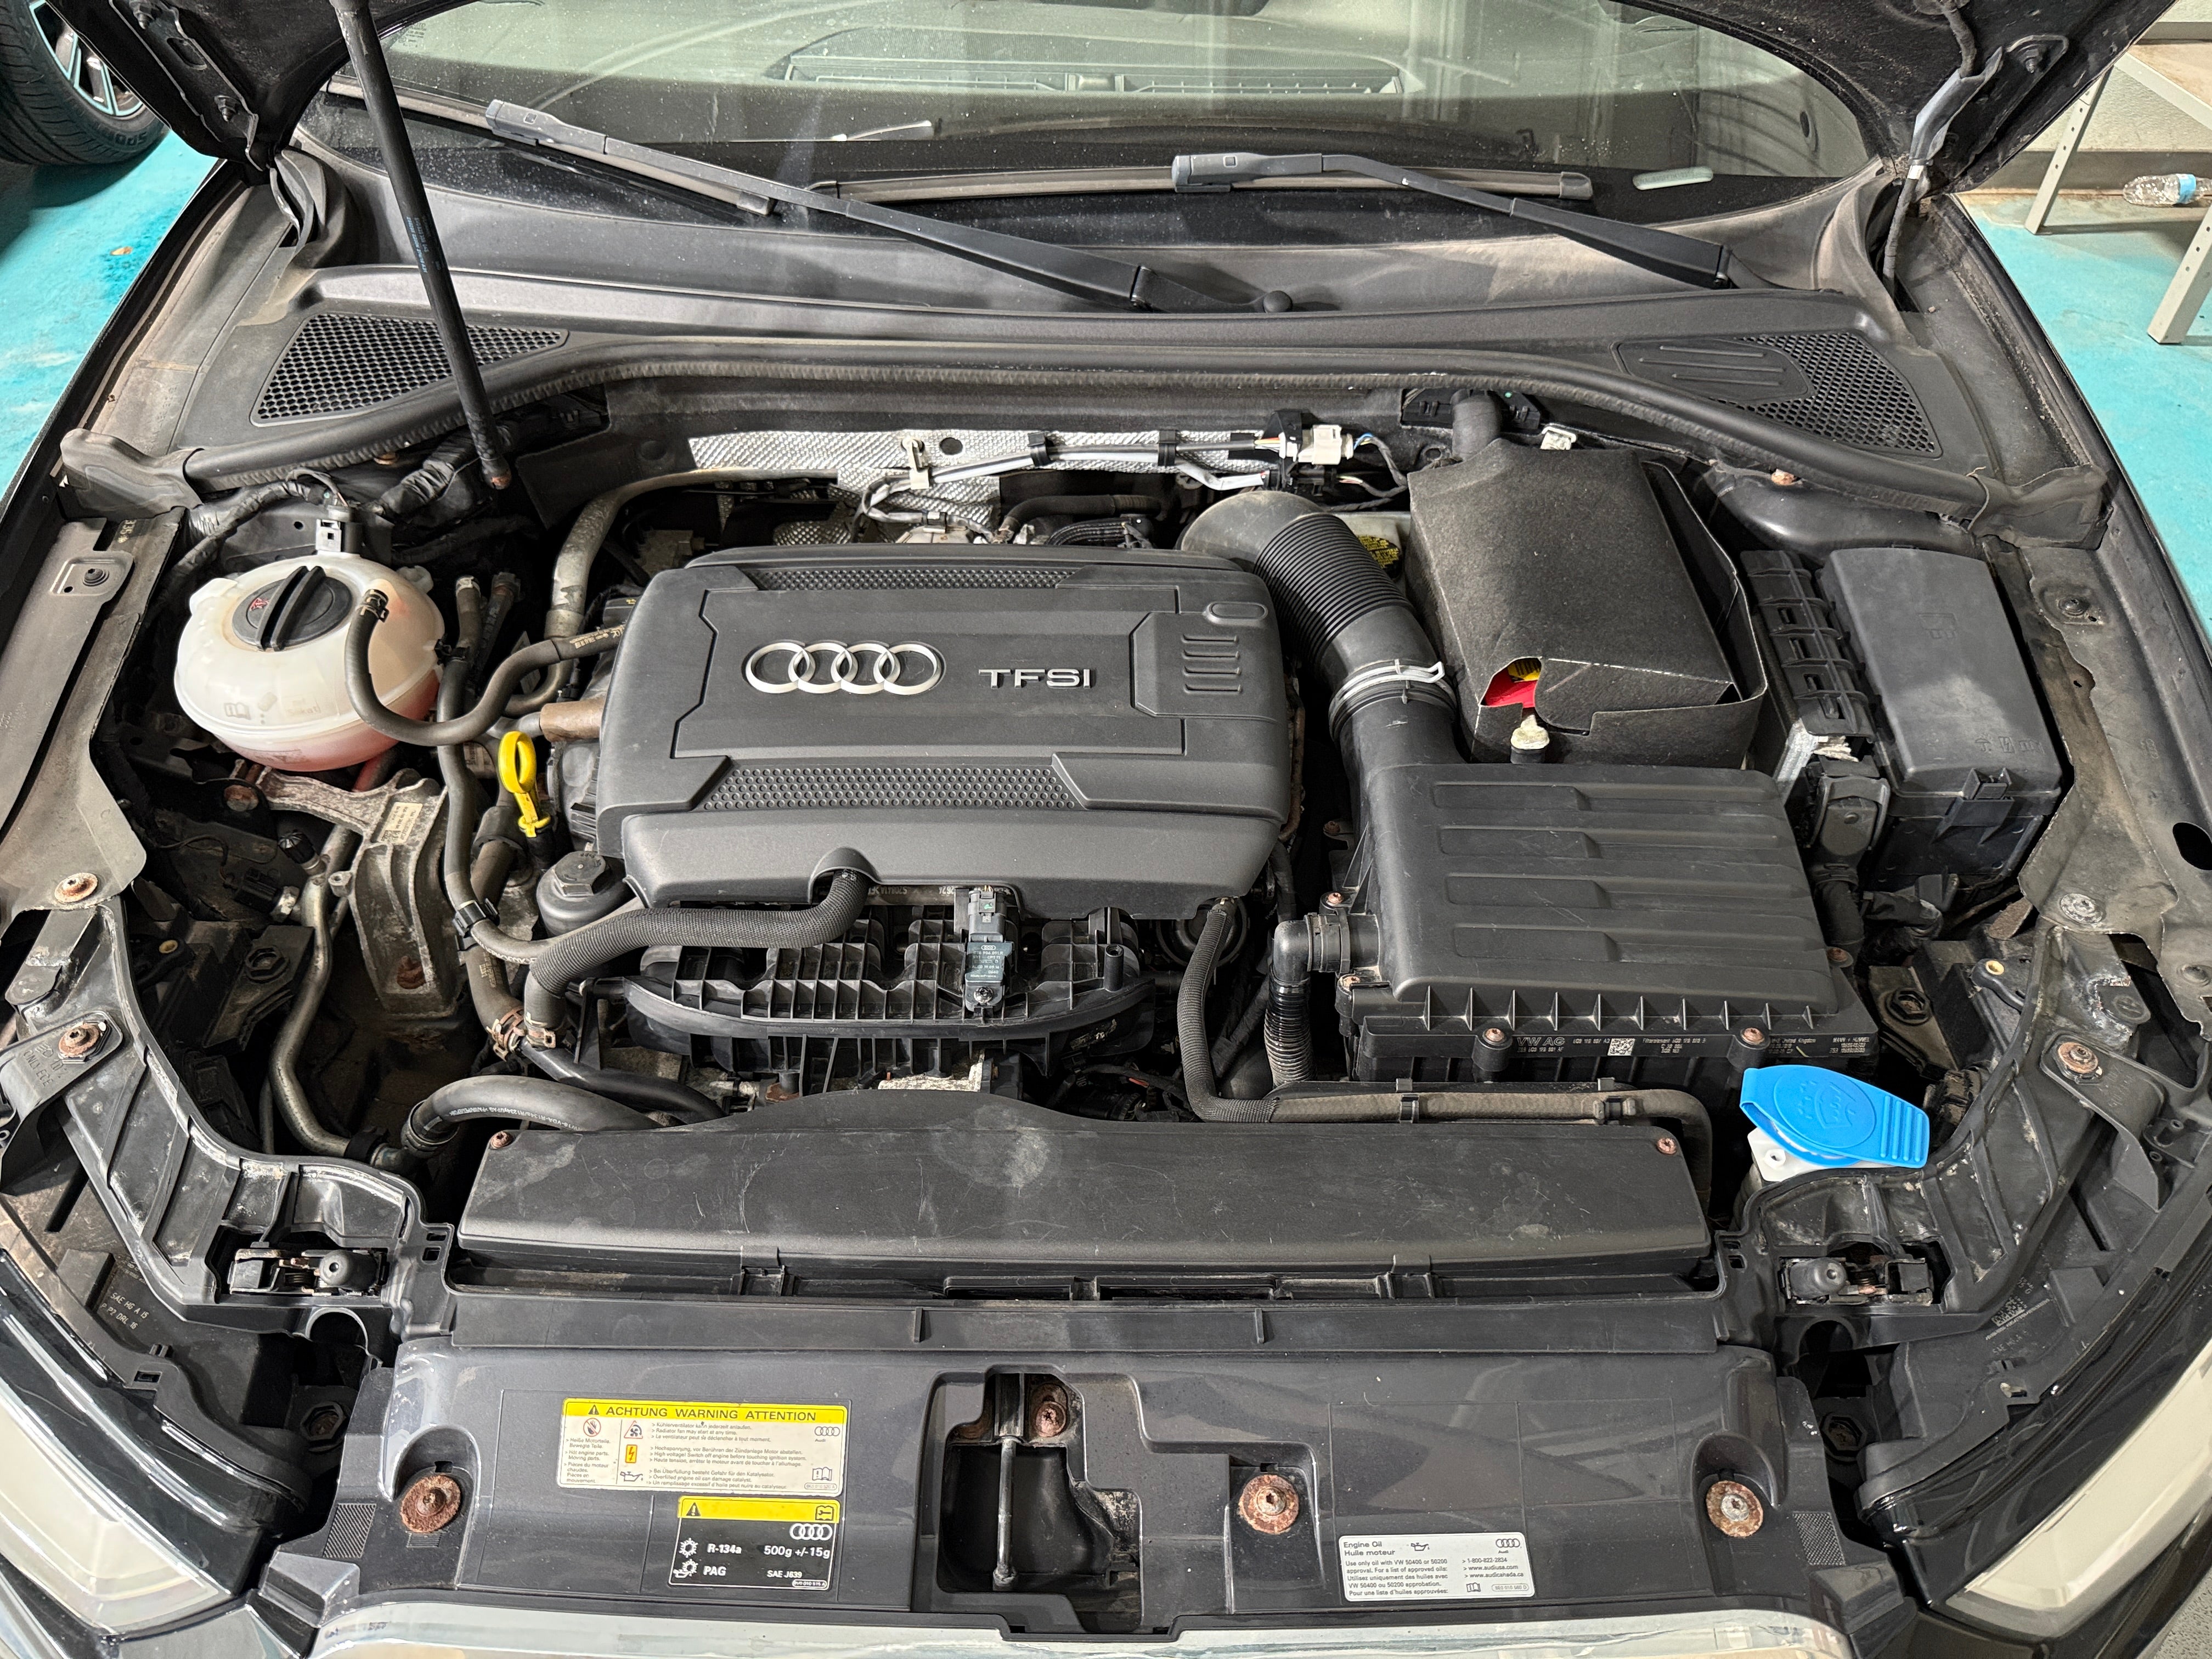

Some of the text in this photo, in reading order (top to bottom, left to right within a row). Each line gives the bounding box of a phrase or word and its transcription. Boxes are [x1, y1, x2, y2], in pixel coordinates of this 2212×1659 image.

[979, 669, 1091, 689] TFSI
[1516, 1036, 1565, 1046] VW AG
[110, 1292, 126, 1304] SAE
[116, 1312, 129, 1325] DRL
[606, 1407, 816, 1421] ACHTUNG WARNING ATTENTION
[707, 1543, 742, 1554] R-134a
[764, 1545, 792, 1558] 500g
[703, 1566, 727, 1576] PAG
